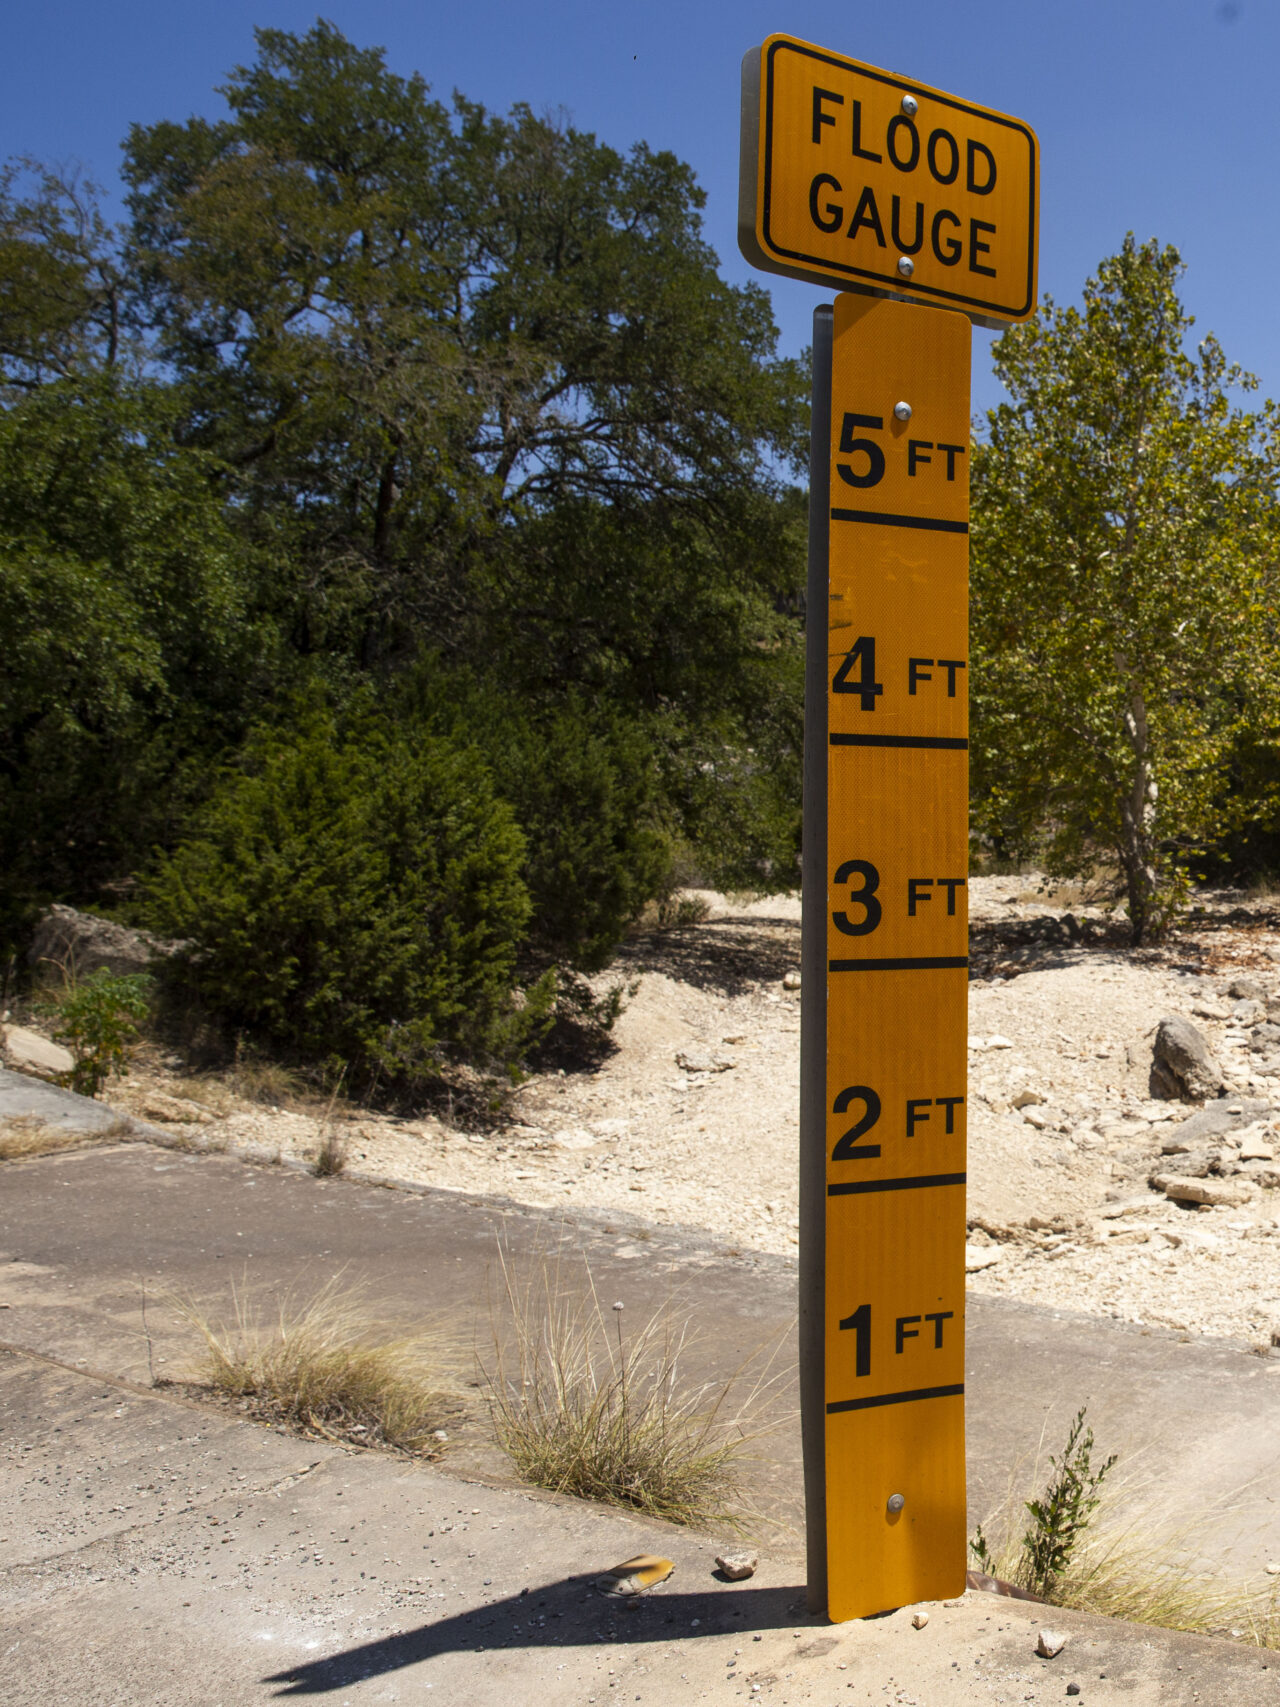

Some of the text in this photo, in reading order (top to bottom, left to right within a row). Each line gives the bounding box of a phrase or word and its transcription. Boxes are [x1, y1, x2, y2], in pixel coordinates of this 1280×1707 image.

[811, 85, 997, 196] FLOOD
[808, 172, 997, 279] GAUGE
[835, 411, 966, 489] 5 FT
[831, 635, 966, 712] 4 FT
[831, 859, 966, 937] 3 FT
[831, 1085, 965, 1162] 2 FT
[838, 1303, 954, 1378] 1 FT
